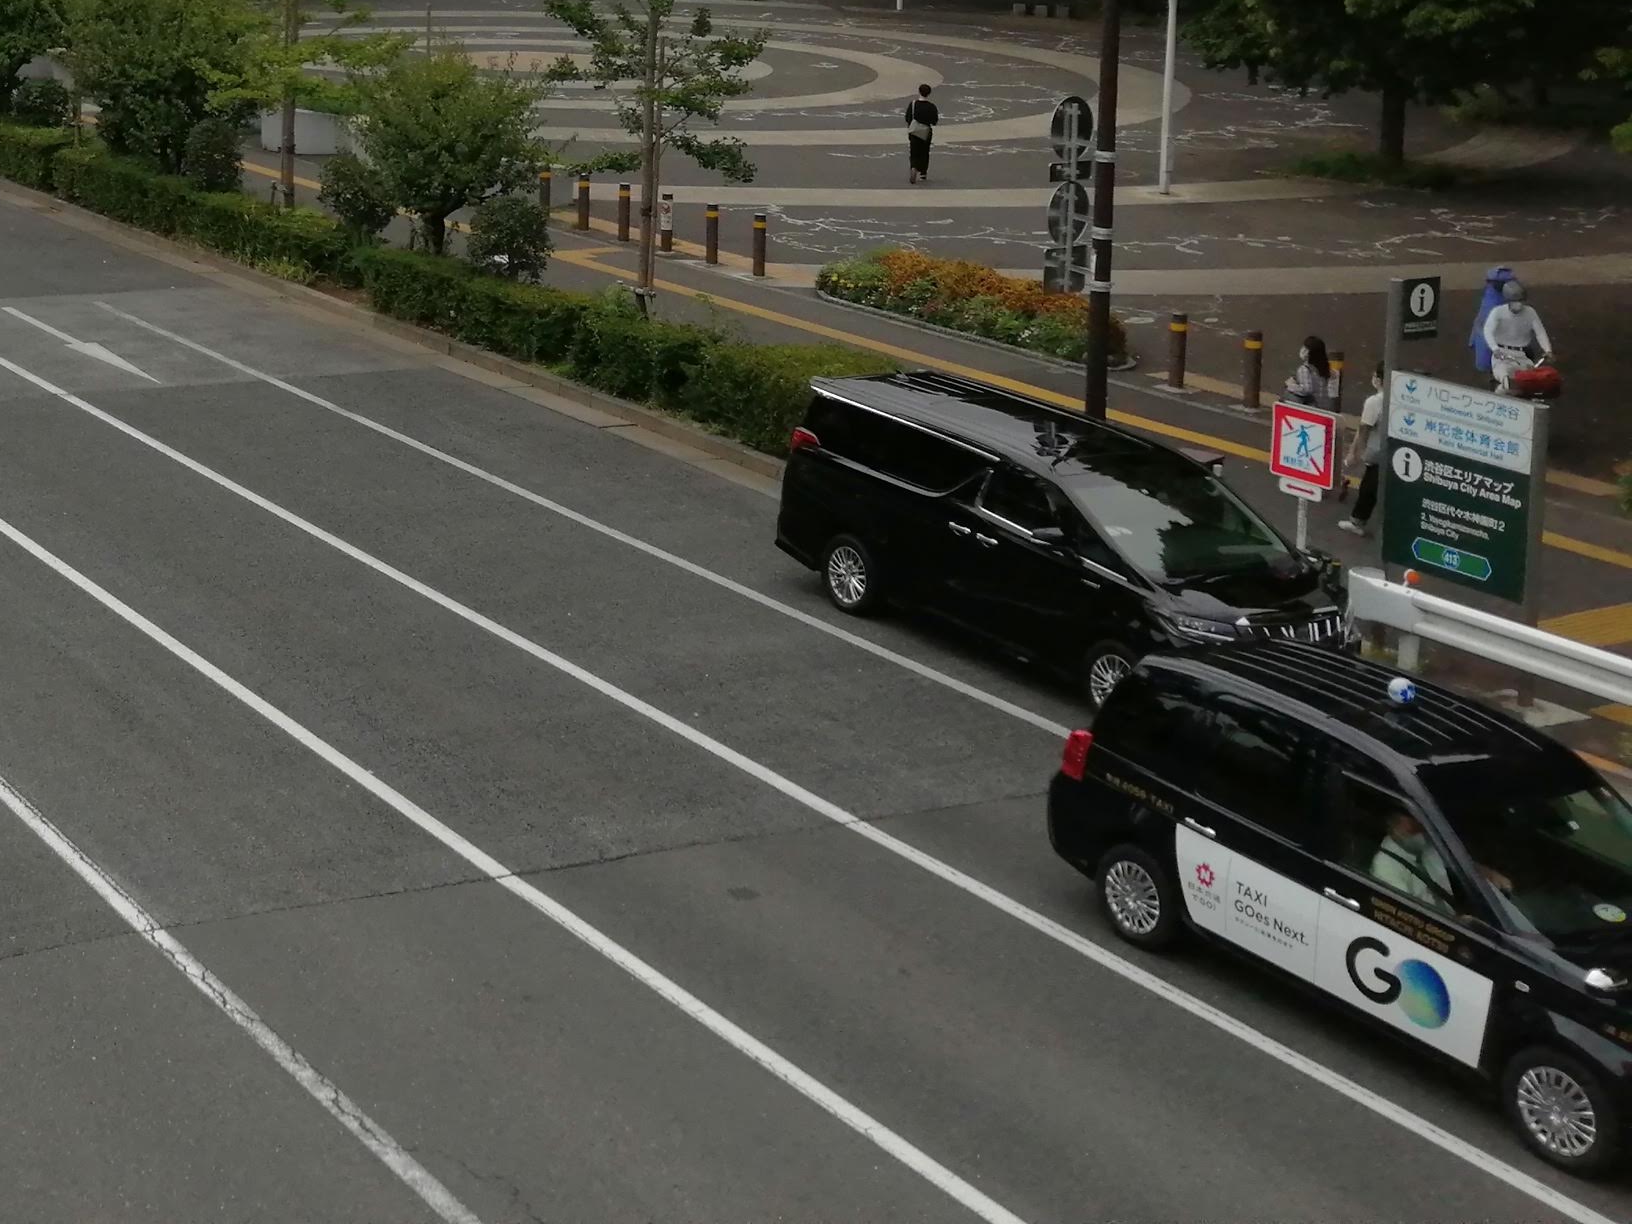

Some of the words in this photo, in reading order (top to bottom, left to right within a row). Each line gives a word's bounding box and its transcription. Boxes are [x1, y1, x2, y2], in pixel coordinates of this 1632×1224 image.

[1427, 386, 1520, 421] ハローワーク渋谷
[1423, 459, 1515, 494] 渋谷区エリアマップ
[1423, 471, 1459, 491] Shibuya
[1460, 482, 1478, 497] City
[1479, 488, 1501, 503] Area
[1502, 494, 1522, 510] Map
[1445, 529, 1460, 541] City
[1444, 552, 1458, 565] 413
[1236, 881, 1267, 907] TAXI
[1234, 899, 1270, 927] GOes
[1273, 917, 1309, 947] Next.
[1345, 936, 1452, 1030] GO
